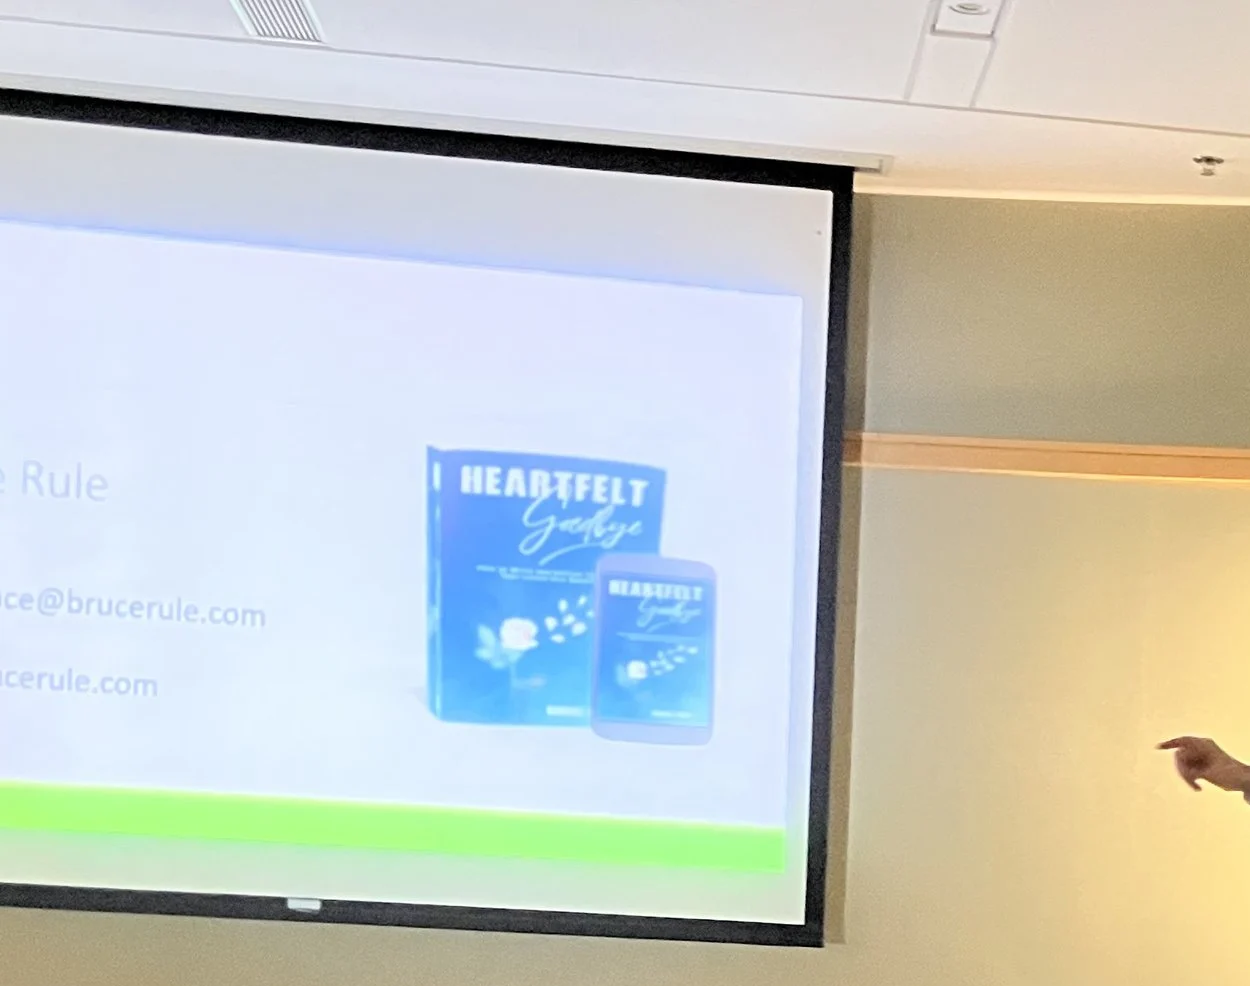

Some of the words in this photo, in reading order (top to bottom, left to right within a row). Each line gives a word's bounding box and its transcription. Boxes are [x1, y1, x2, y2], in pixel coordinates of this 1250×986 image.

[21, 459, 109, 502] Rule
[461, 464, 649, 507] HEARTFELT
[0, 667, 158, 697] cerule.com
